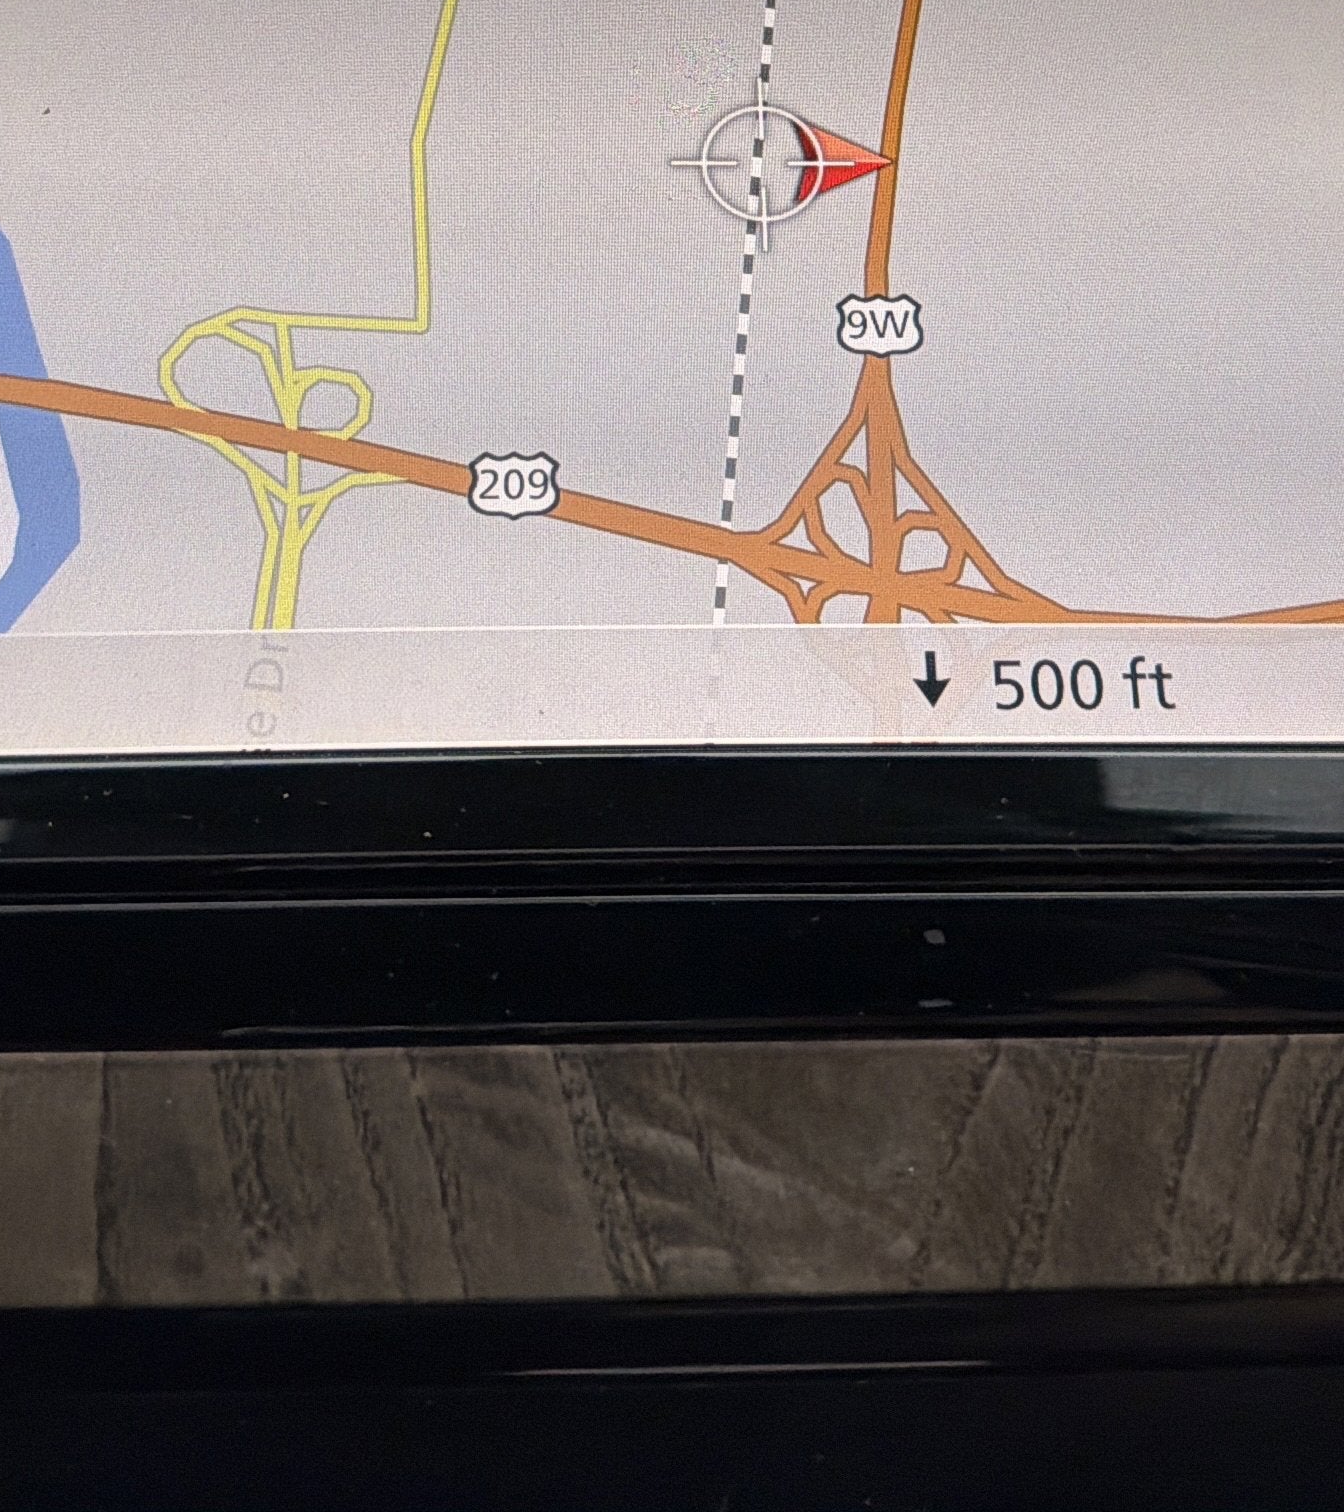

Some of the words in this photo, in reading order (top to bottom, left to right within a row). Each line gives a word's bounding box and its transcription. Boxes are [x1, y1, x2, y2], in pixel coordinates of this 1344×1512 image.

[847, 309, 910, 339] 9W
[479, 468, 550, 501] 209
[993, 658, 1105, 711] 500
[1122, 655, 1176, 710] ft
